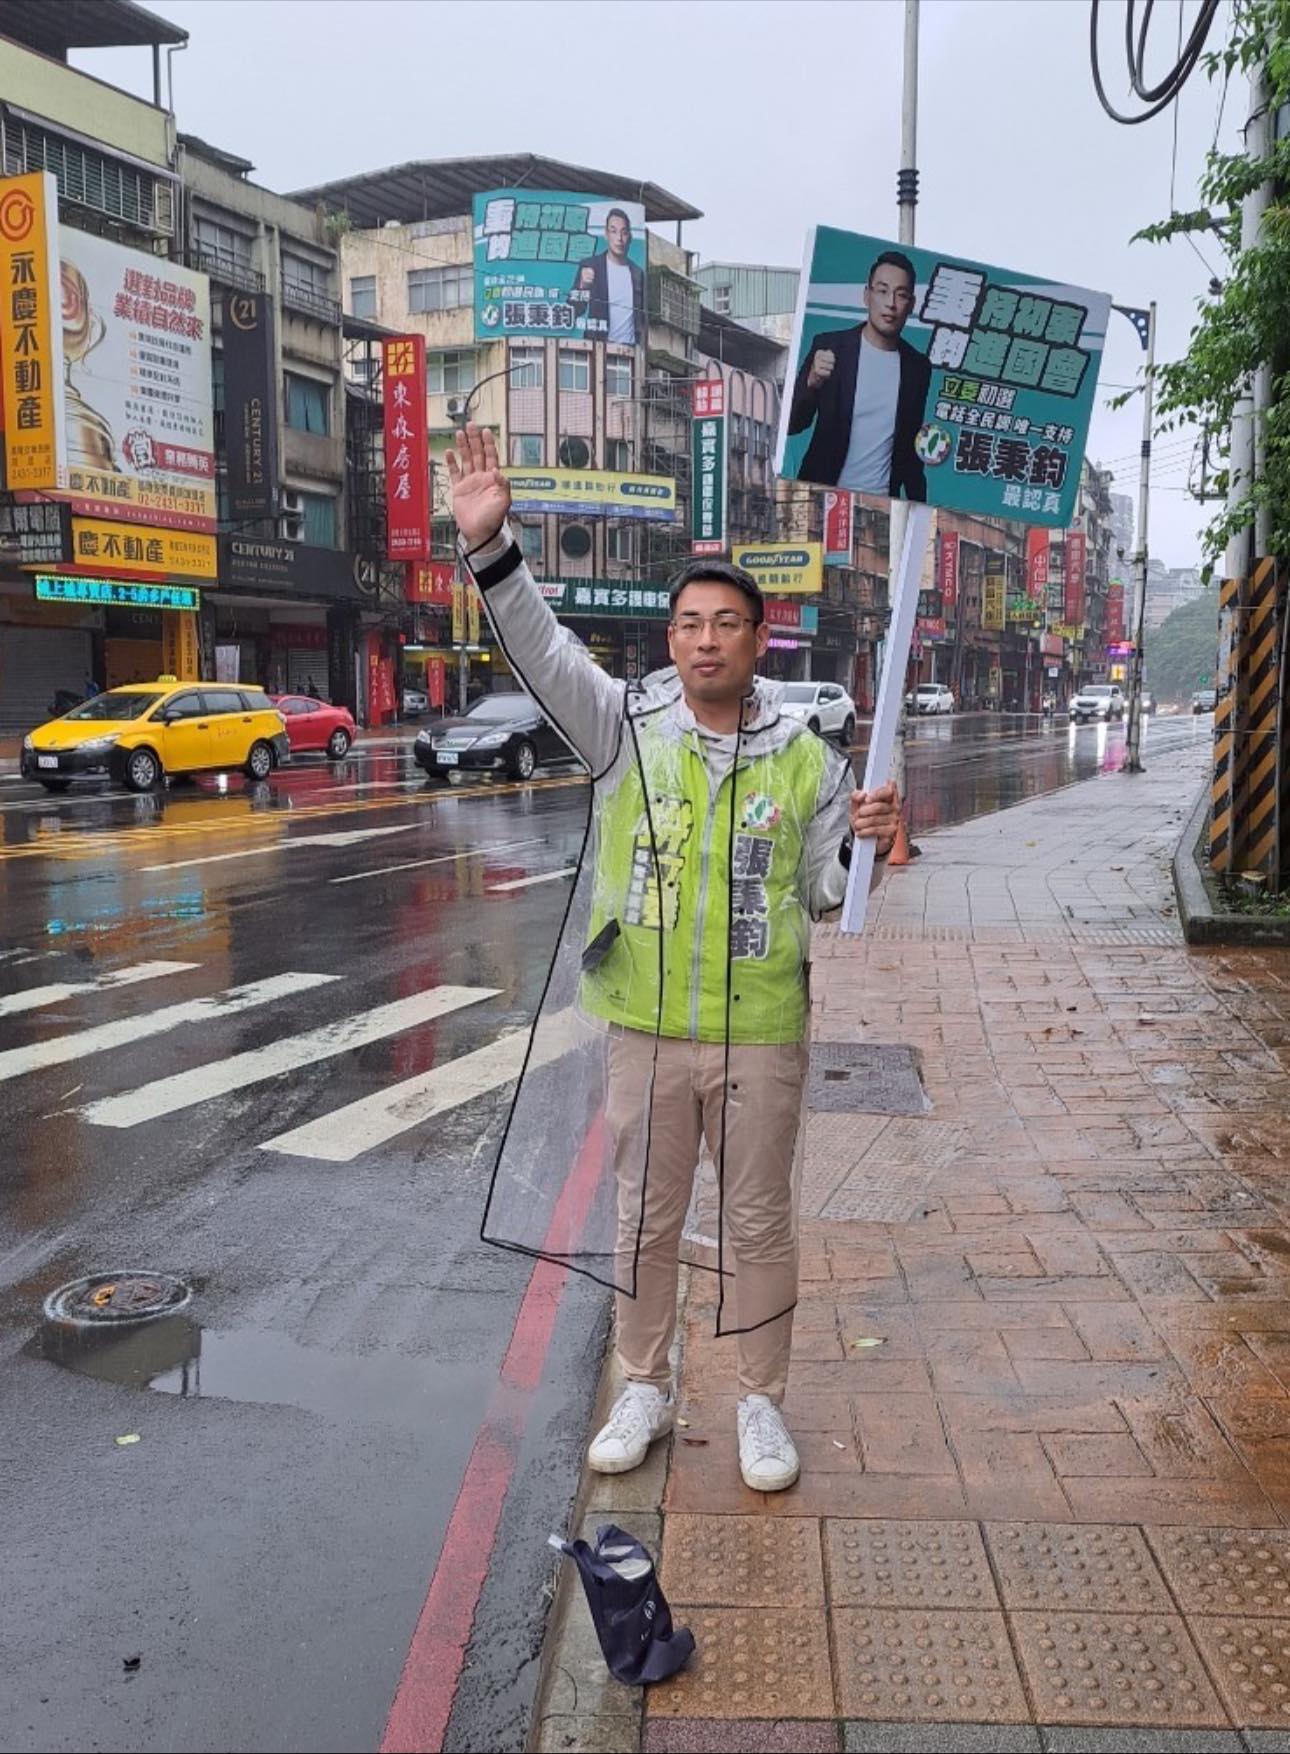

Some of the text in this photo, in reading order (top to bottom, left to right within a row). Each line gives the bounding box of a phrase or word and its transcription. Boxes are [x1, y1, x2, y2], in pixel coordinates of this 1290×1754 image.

[124, 267, 196, 313] 選對品牌
[114, 292, 205, 341] 業績自然來
[504, 301, 575, 329] 張秉鈞
[11, 250, 42, 430] 永慶不動產
[940, 377, 1016, 410] 立委初選
[251, 398, 262, 484] CENTURY 21
[391, 380, 415, 499] 東森房屋
[935, 400, 1075, 444] 電話全民調 唯一支持
[954, 428, 1068, 490] 張秉鈞
[69, 473, 133, 499] 慶不動產
[1001, 484, 1062, 514] 最認真
[78, 531, 164, 564] 慶不動產
[231, 542, 284, 560] CENTURY
[745, 553, 804, 566] GOODYEAR
[944, 552, 953, 597] KYMCO
[732, 834, 775, 960] 張秉鈞
